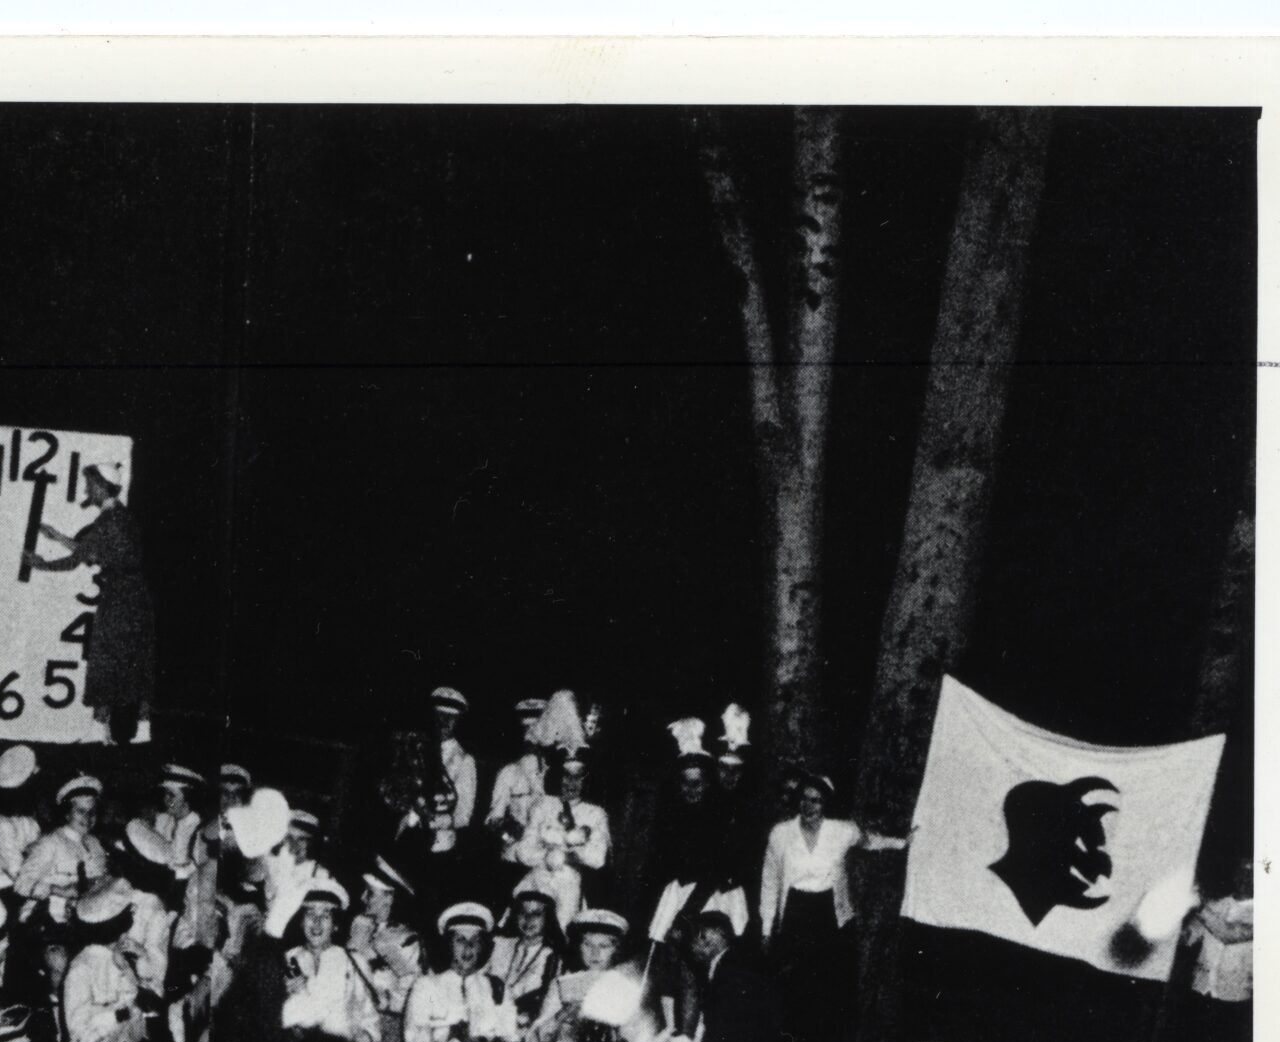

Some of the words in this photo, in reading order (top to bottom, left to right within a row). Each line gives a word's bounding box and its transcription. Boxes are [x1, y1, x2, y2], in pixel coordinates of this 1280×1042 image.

[10, 429, 59, 483] 12
[67, 451, 80, 503] 1
[60, 611, 94, 660] 4
[42, 660, 78, 709] 5
